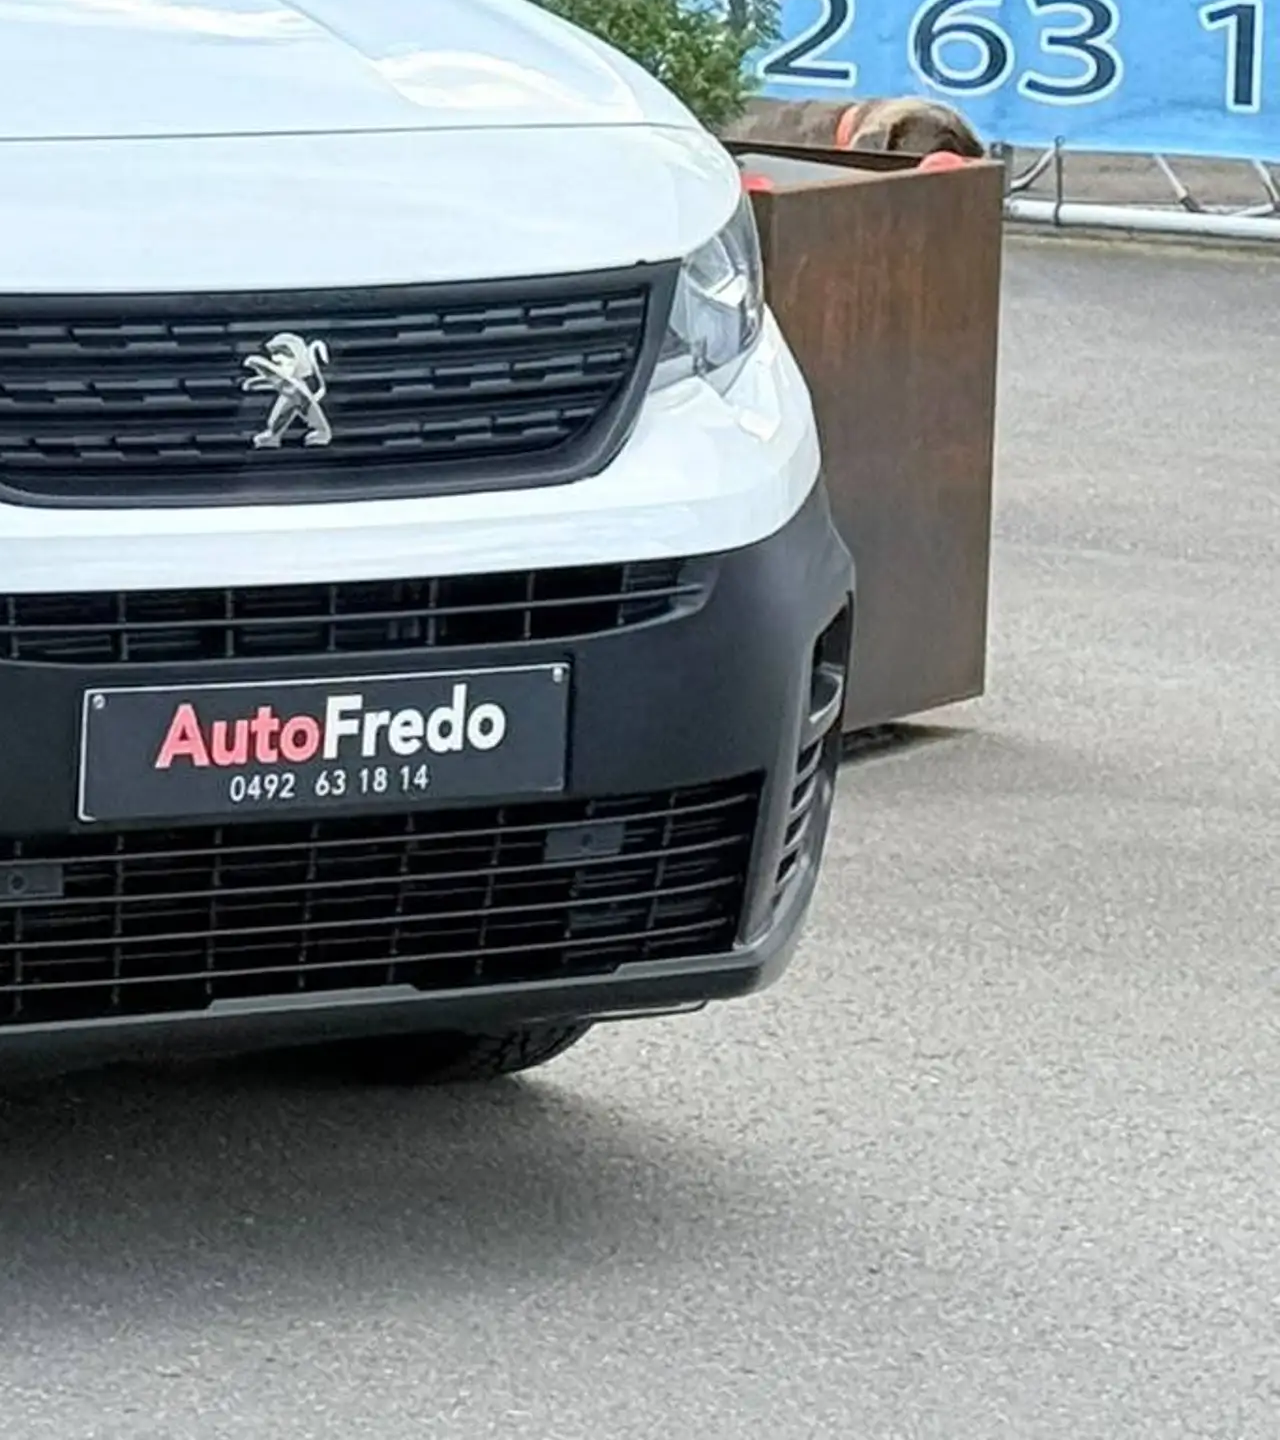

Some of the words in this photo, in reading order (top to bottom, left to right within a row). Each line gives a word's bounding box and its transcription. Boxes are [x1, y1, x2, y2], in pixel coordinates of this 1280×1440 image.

[154, 683, 507, 769] AutoFredo
[229, 772, 296, 802] 0492
[314, 769, 347, 797] 63
[359, 766, 389, 794] 18
[399, 763, 430, 791] 14
